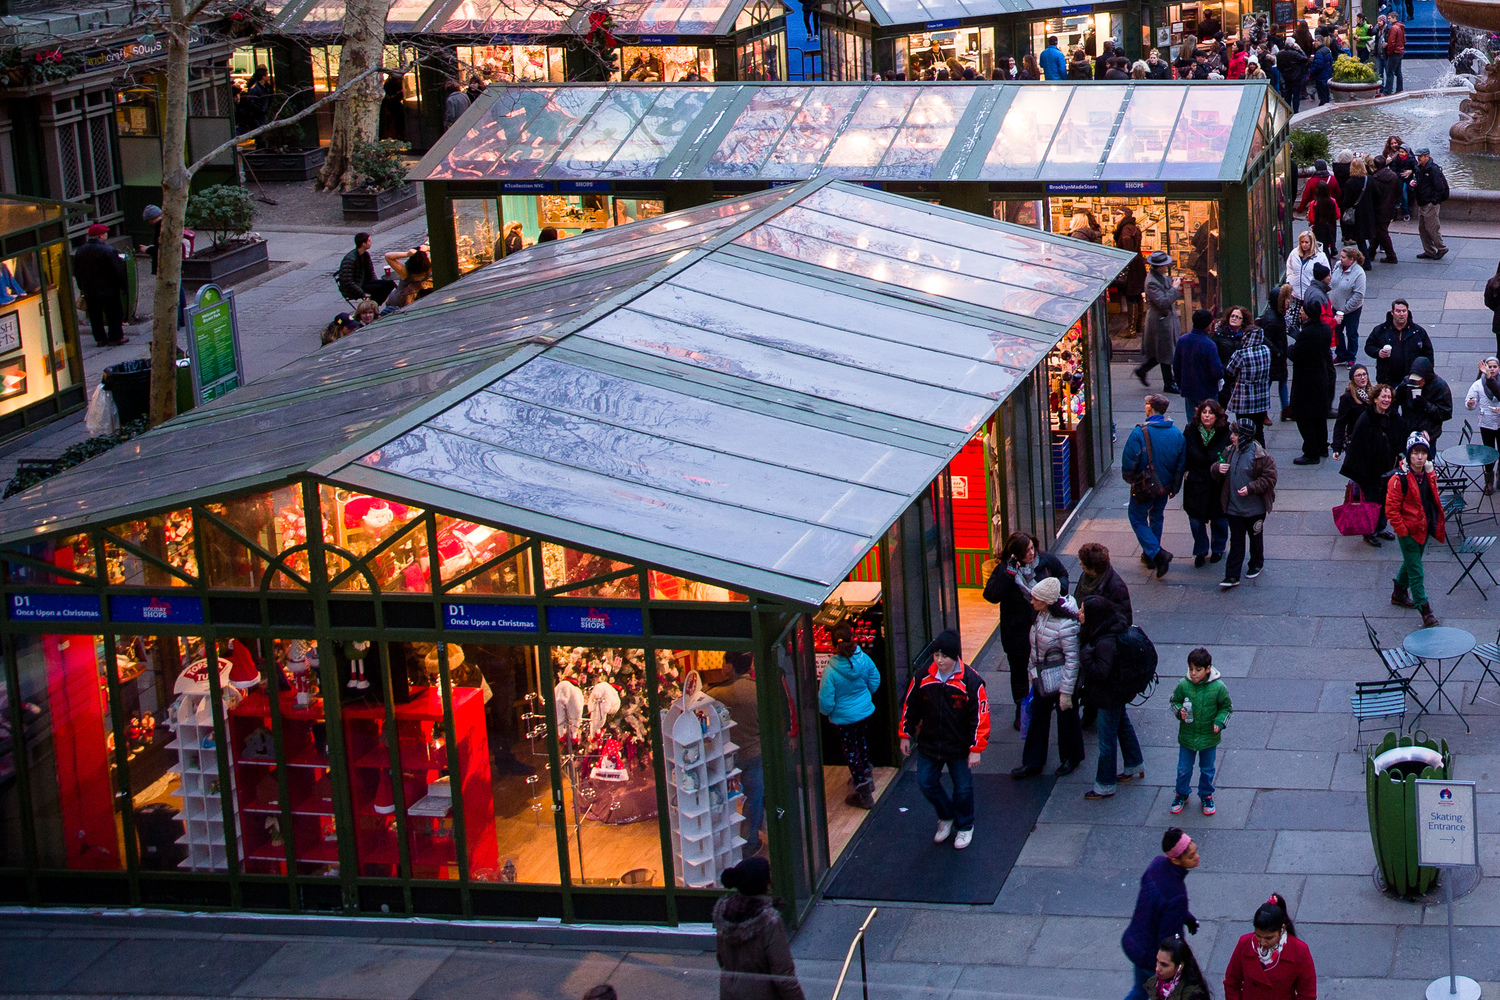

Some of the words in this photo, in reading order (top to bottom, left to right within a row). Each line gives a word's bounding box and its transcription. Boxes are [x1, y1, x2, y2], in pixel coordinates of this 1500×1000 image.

[132, 40, 162, 56] soups
[15, 596, 30, 606] D1
[450, 605, 465, 615] D1
[471, 619, 490, 627] Upon
[498, 619, 534, 628] Christmas
[1431, 812, 1462, 823] Skating
[1428, 822, 1466, 831] Entrance
